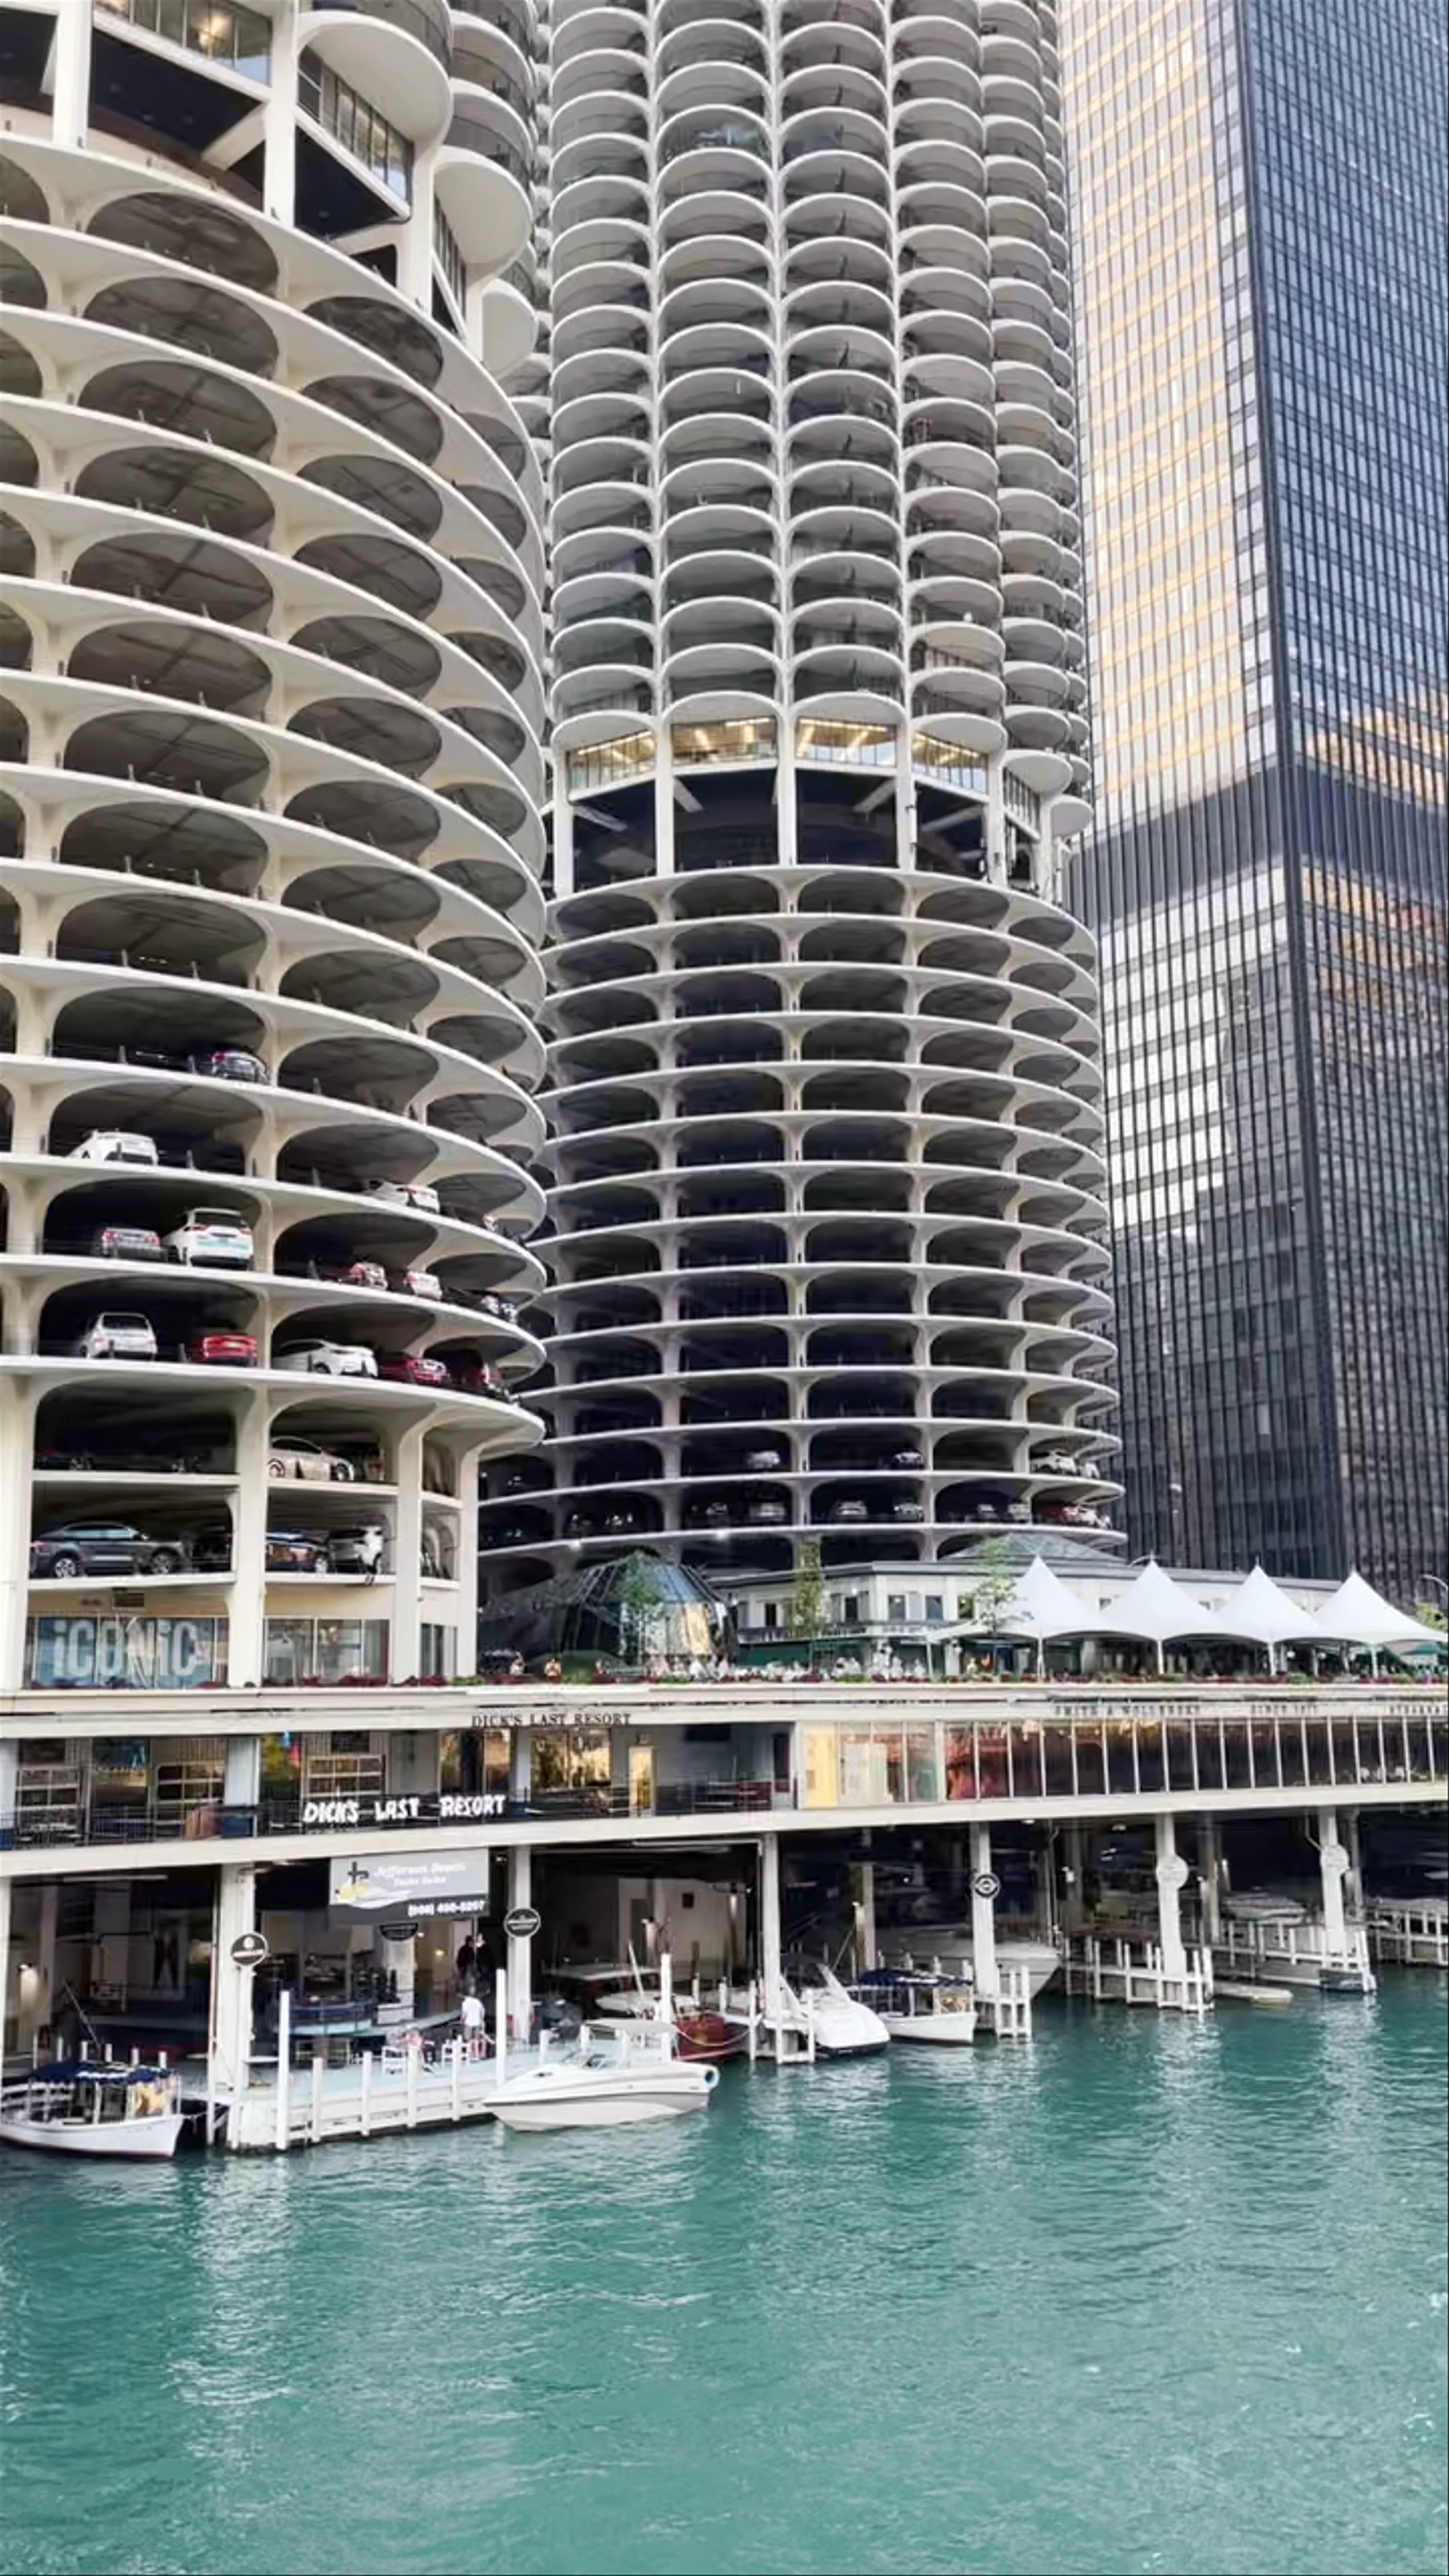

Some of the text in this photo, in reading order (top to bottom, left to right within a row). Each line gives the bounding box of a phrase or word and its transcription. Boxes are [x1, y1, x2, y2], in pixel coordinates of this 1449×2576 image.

[472, 1713, 632, 1728] DICK'S LAST RESORT
[303, 1795, 506, 1823] DICK'S LAST RESORT
